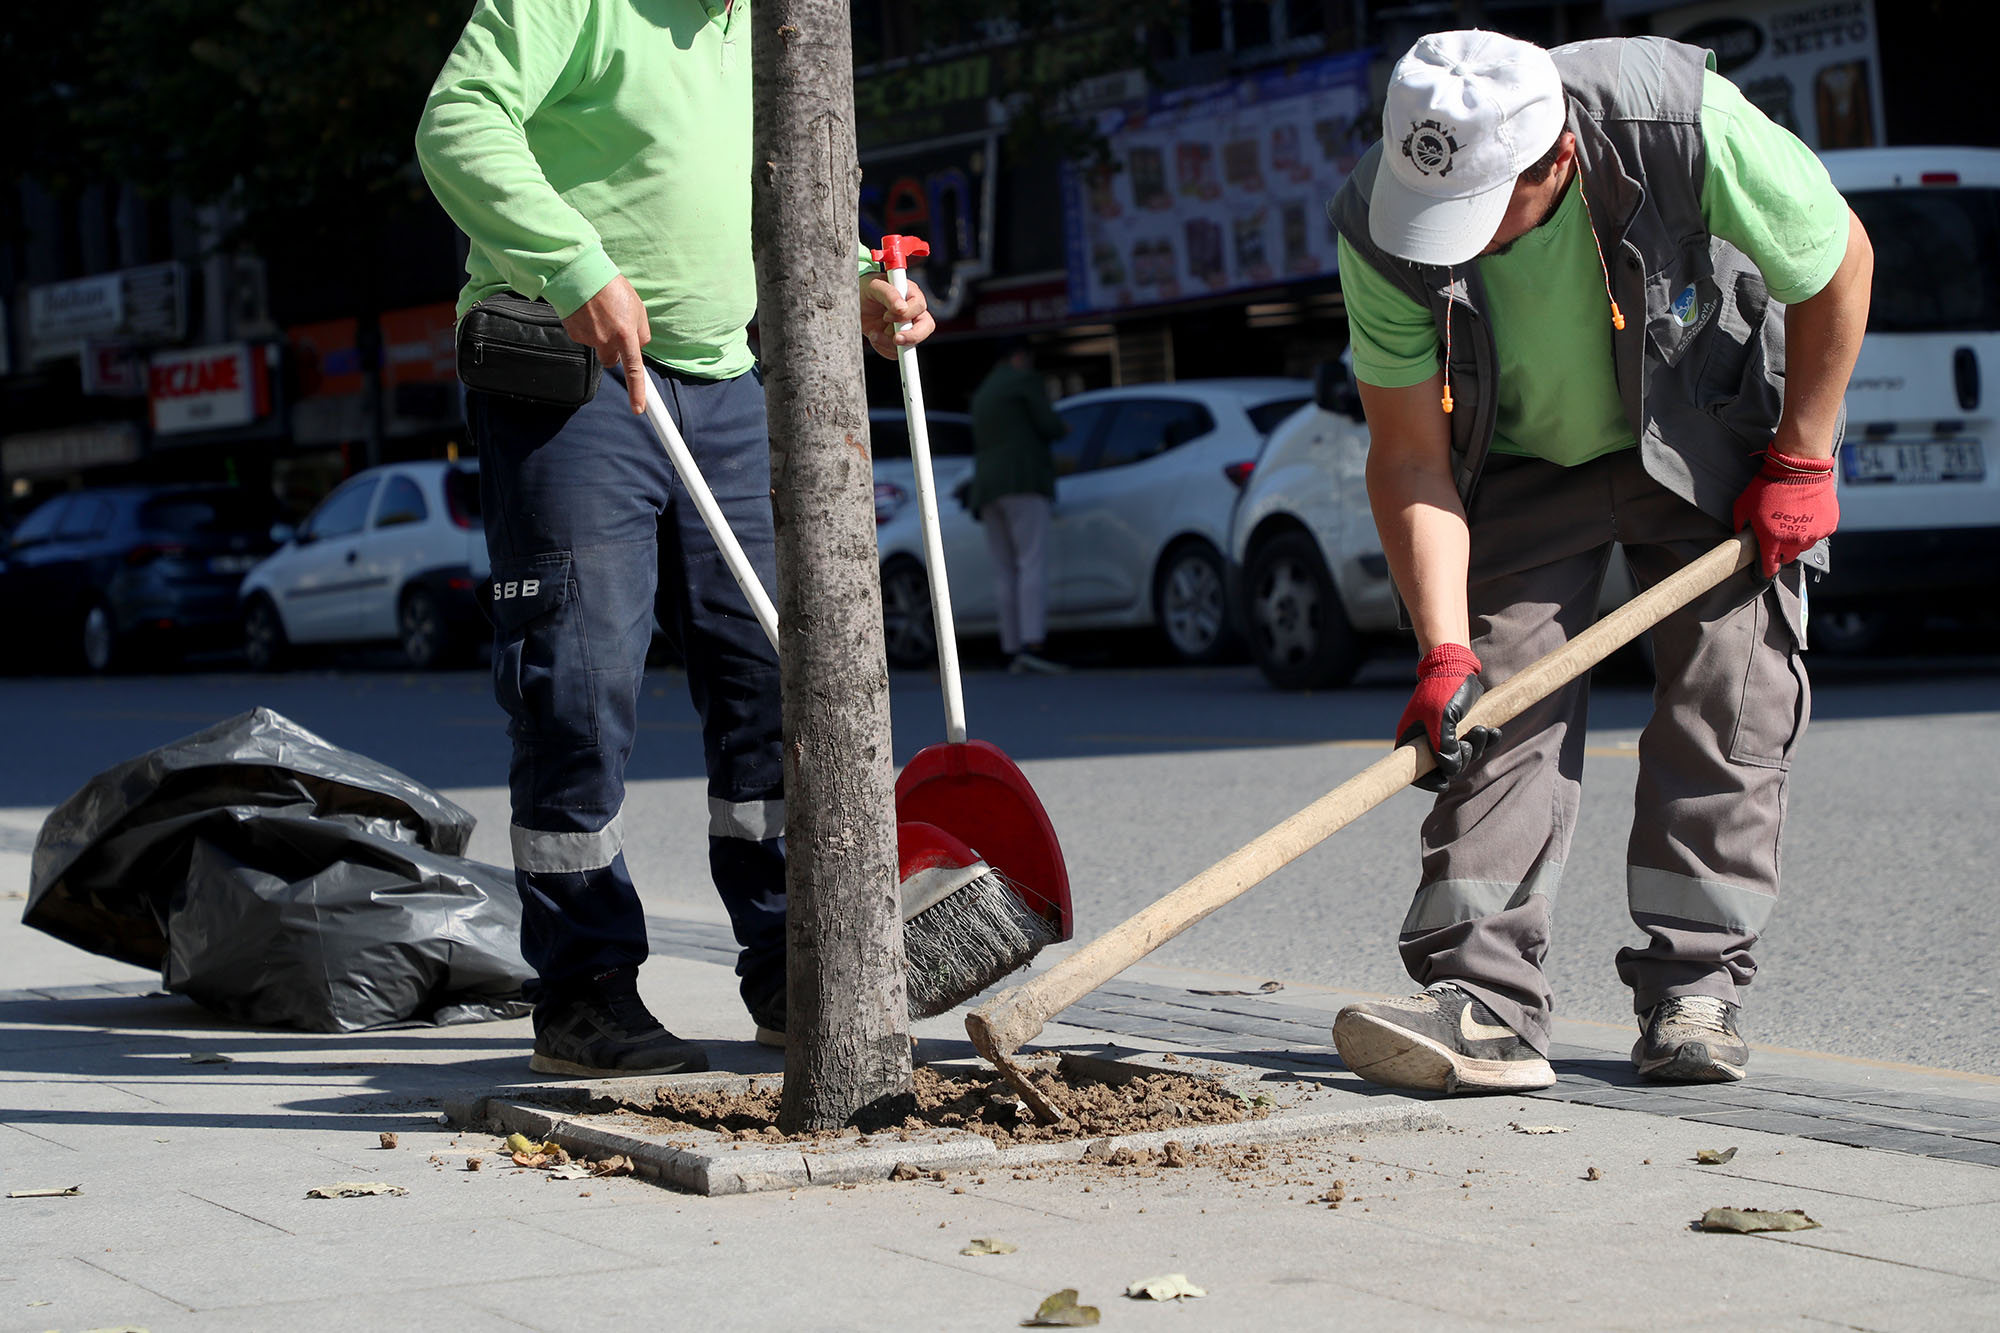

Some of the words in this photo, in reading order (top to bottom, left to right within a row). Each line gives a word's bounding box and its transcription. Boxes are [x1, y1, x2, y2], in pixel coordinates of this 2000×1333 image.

[1772, 21, 1867, 56] NETTO
[1771, 511, 1814, 524] Beybi
[1780, 523, 1807, 532] Pn75
[494, 579, 540, 600] SBB
